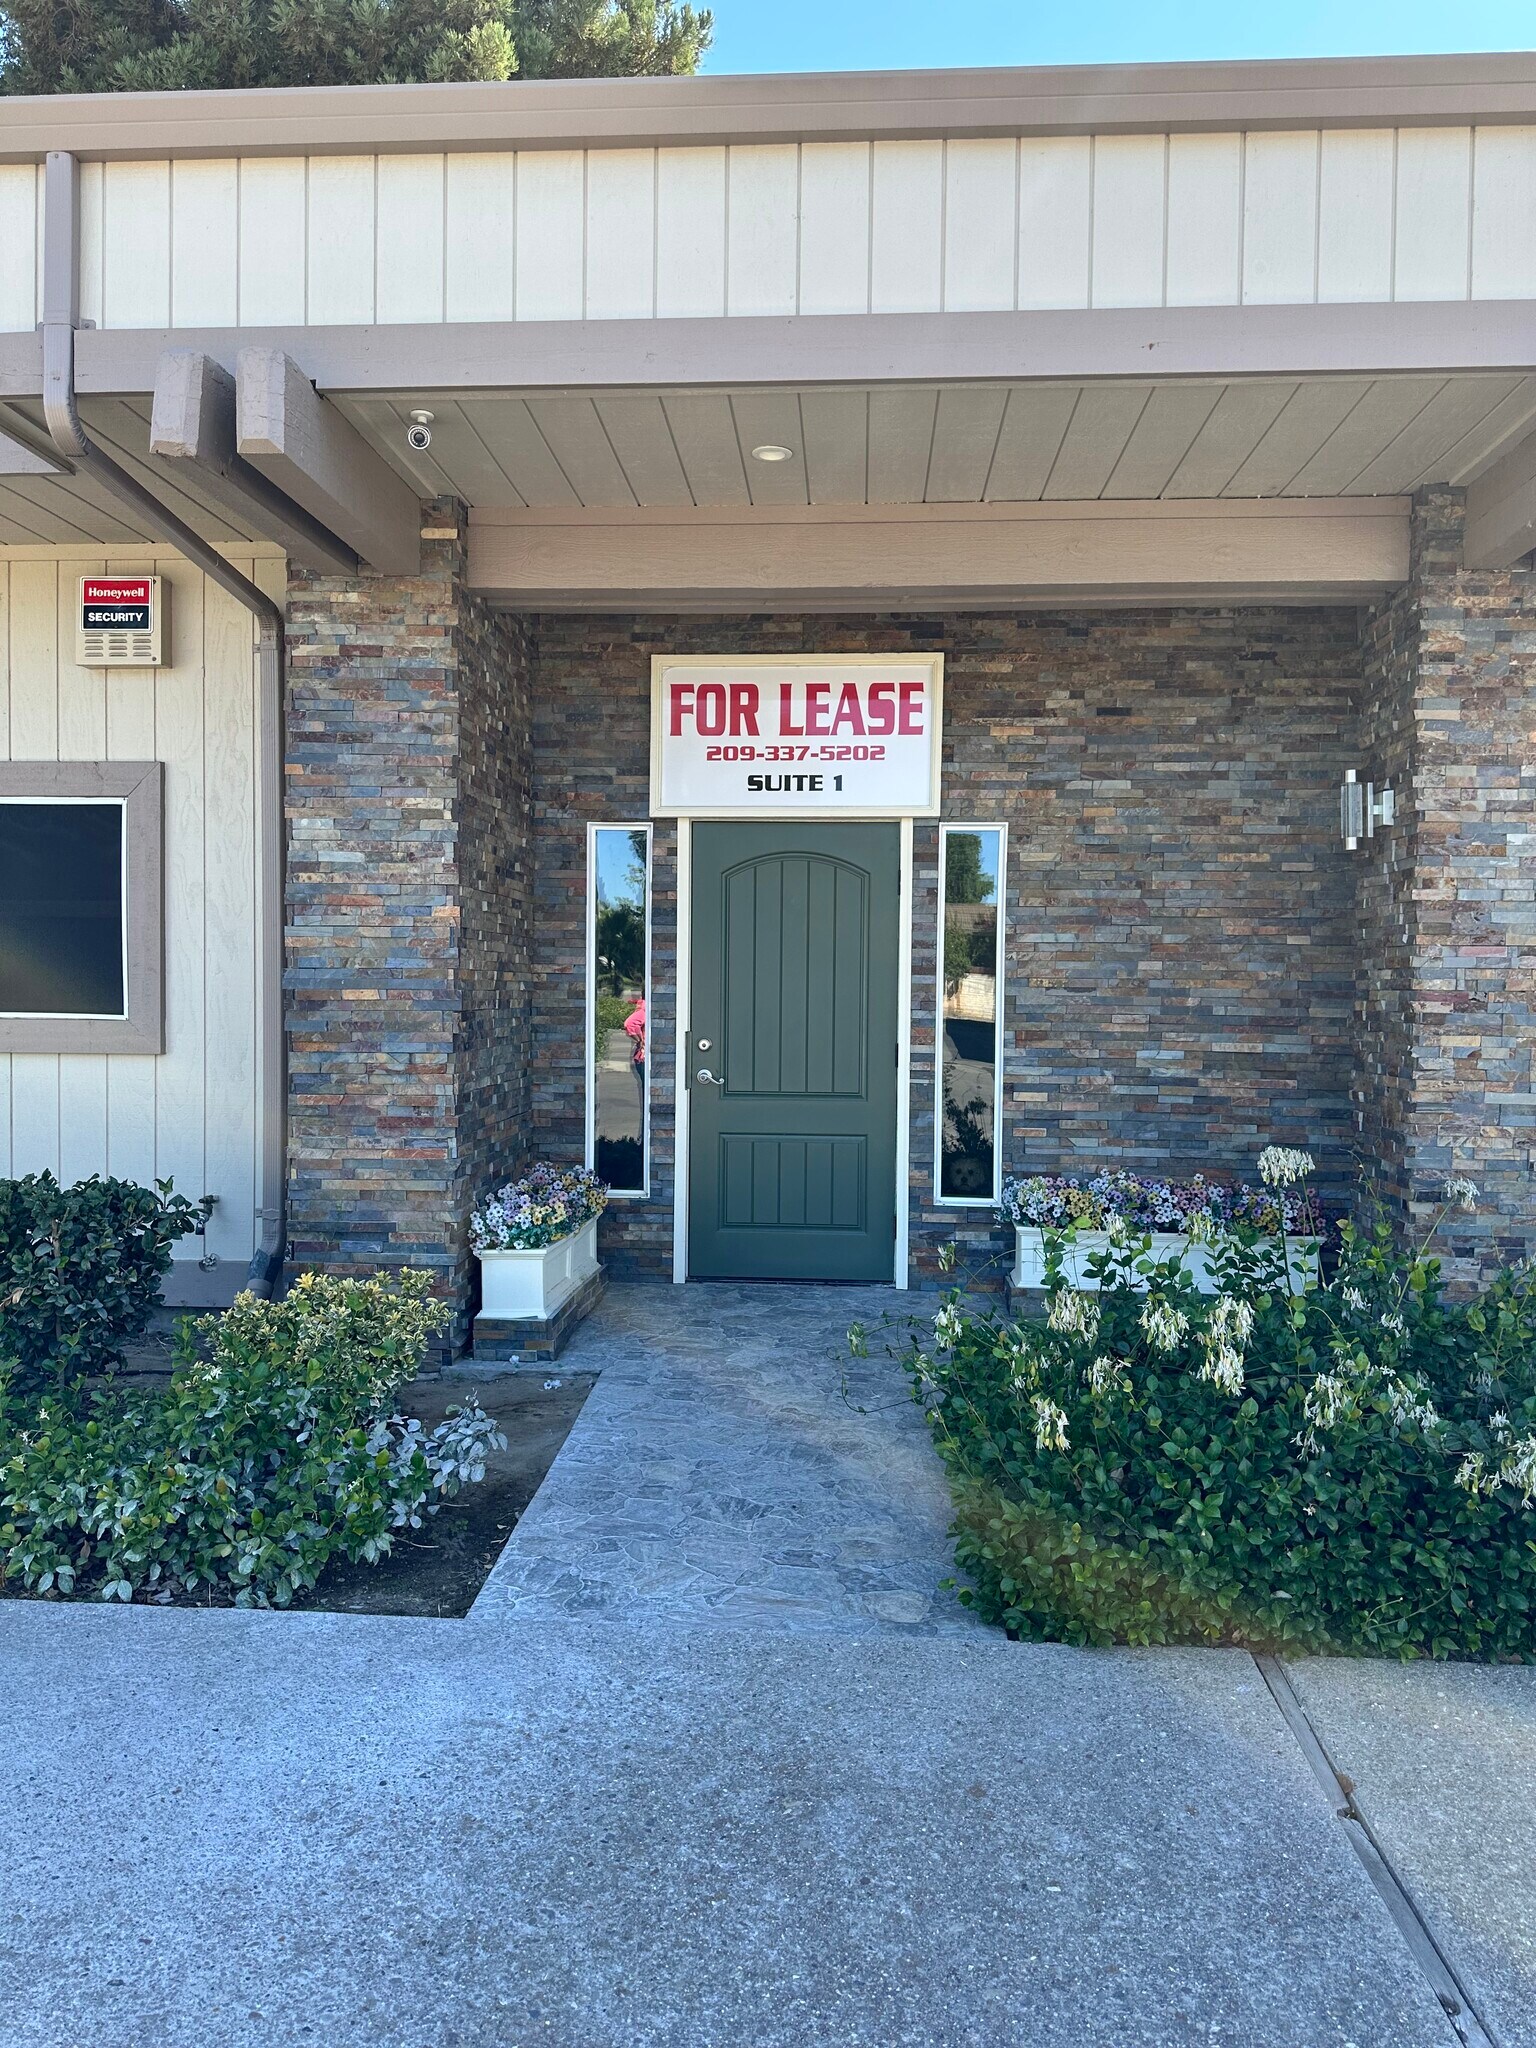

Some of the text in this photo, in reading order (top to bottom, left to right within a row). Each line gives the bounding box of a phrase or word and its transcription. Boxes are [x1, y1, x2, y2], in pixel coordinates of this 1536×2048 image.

[88, 587, 144, 599] Honeywell
[88, 612, 143, 622] SECURITY
[669, 682, 925, 736] FOR LEASE
[706, 745, 886, 761] 209-337-5202
[747, 774, 843, 792] SUITE 1
